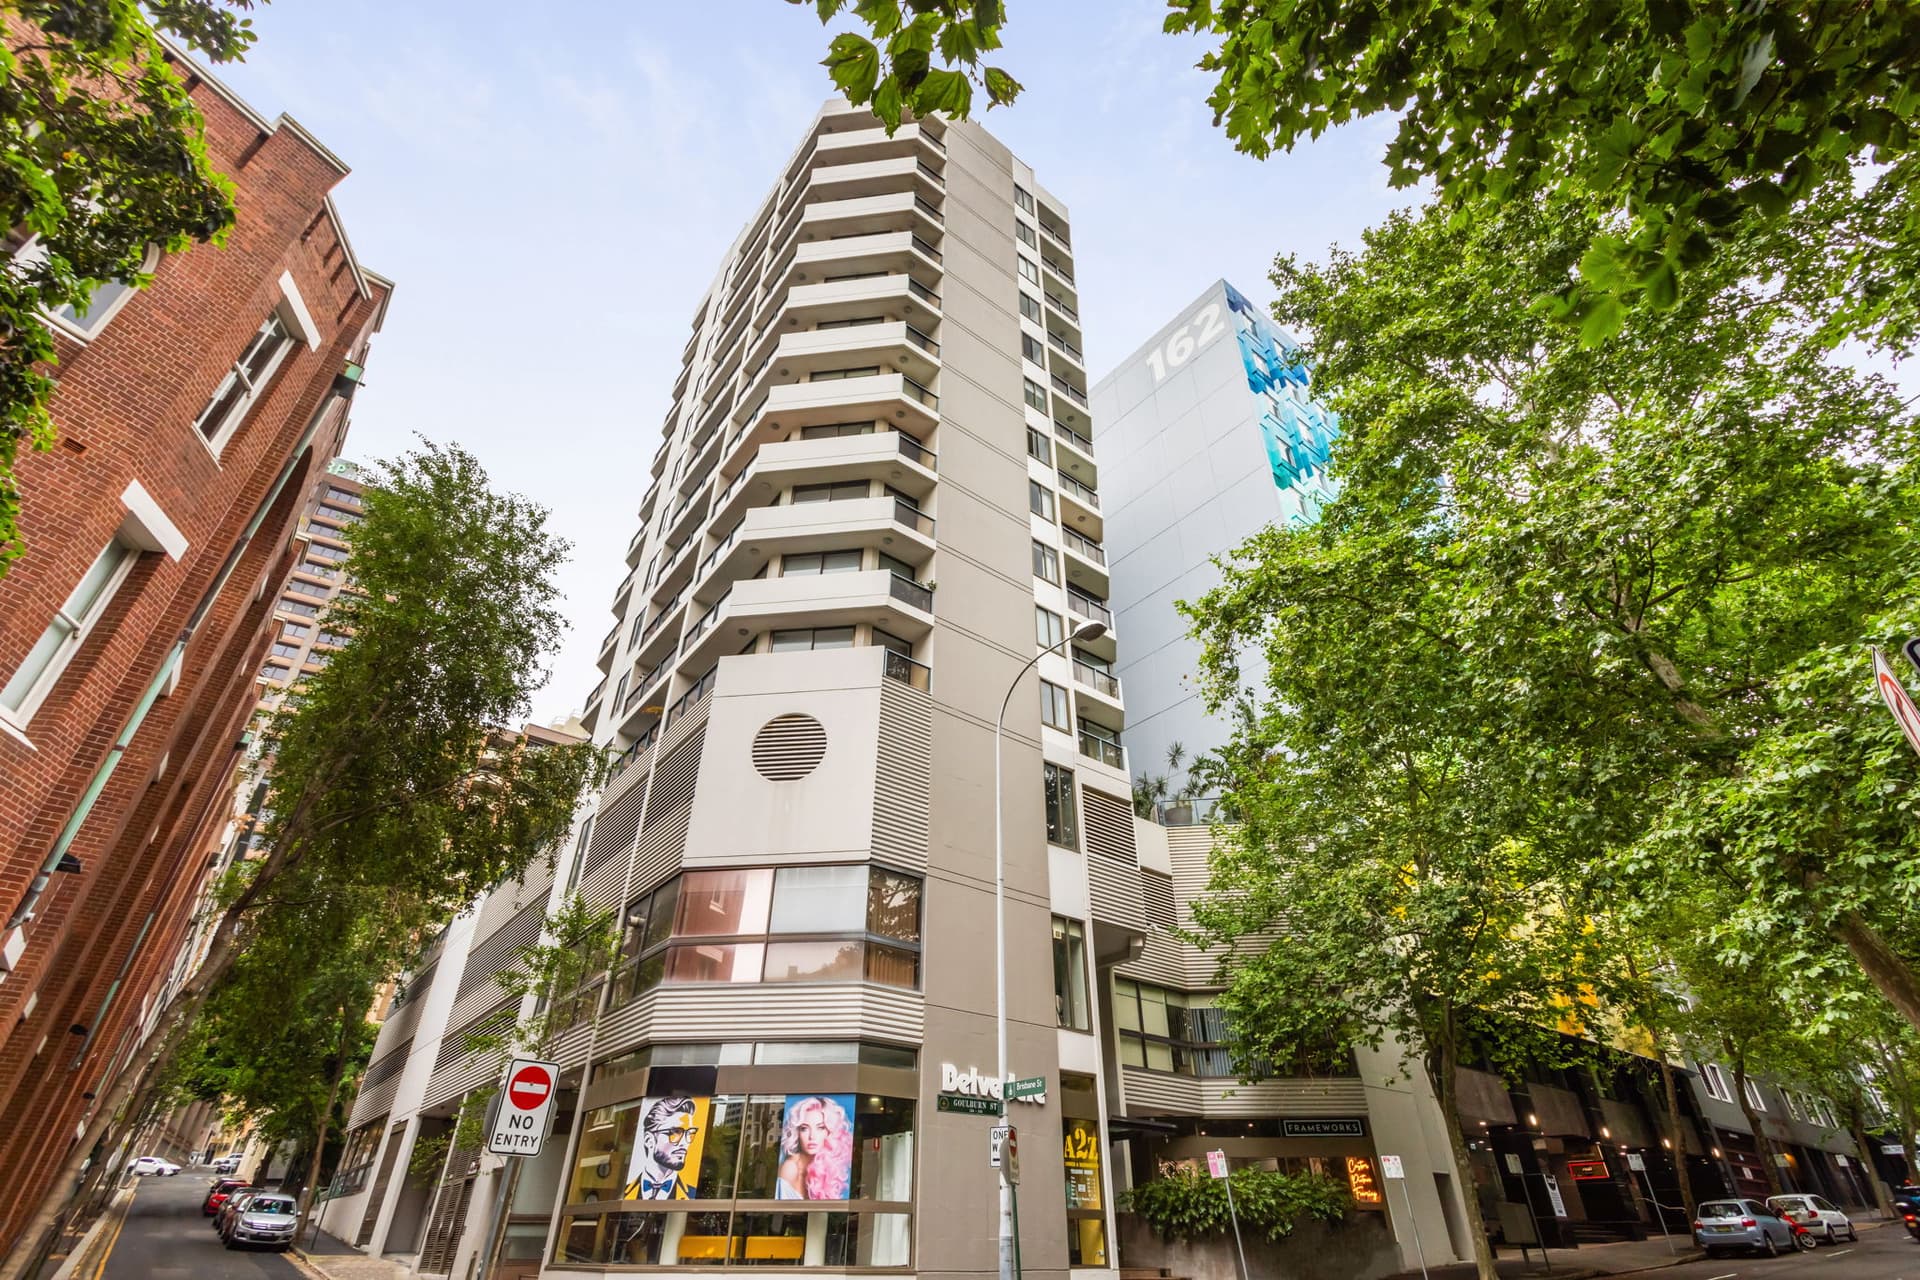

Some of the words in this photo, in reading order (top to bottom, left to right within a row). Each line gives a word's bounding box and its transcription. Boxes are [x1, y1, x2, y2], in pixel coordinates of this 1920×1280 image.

[1146, 303, 1225, 382] 162
[1016, 1081, 1036, 1091] Brisbane
[1036, 1079, 1042, 1088] St
[953, 1098, 987, 1109] GOULBURN
[989, 1102, 998, 1111] ST
[509, 1114, 534, 1130] NO
[1287, 1123, 1358, 1132] FRAMEWORKS
[495, 1133, 539, 1148] ENTRY
[1064, 1128, 1099, 1160] A2Z
